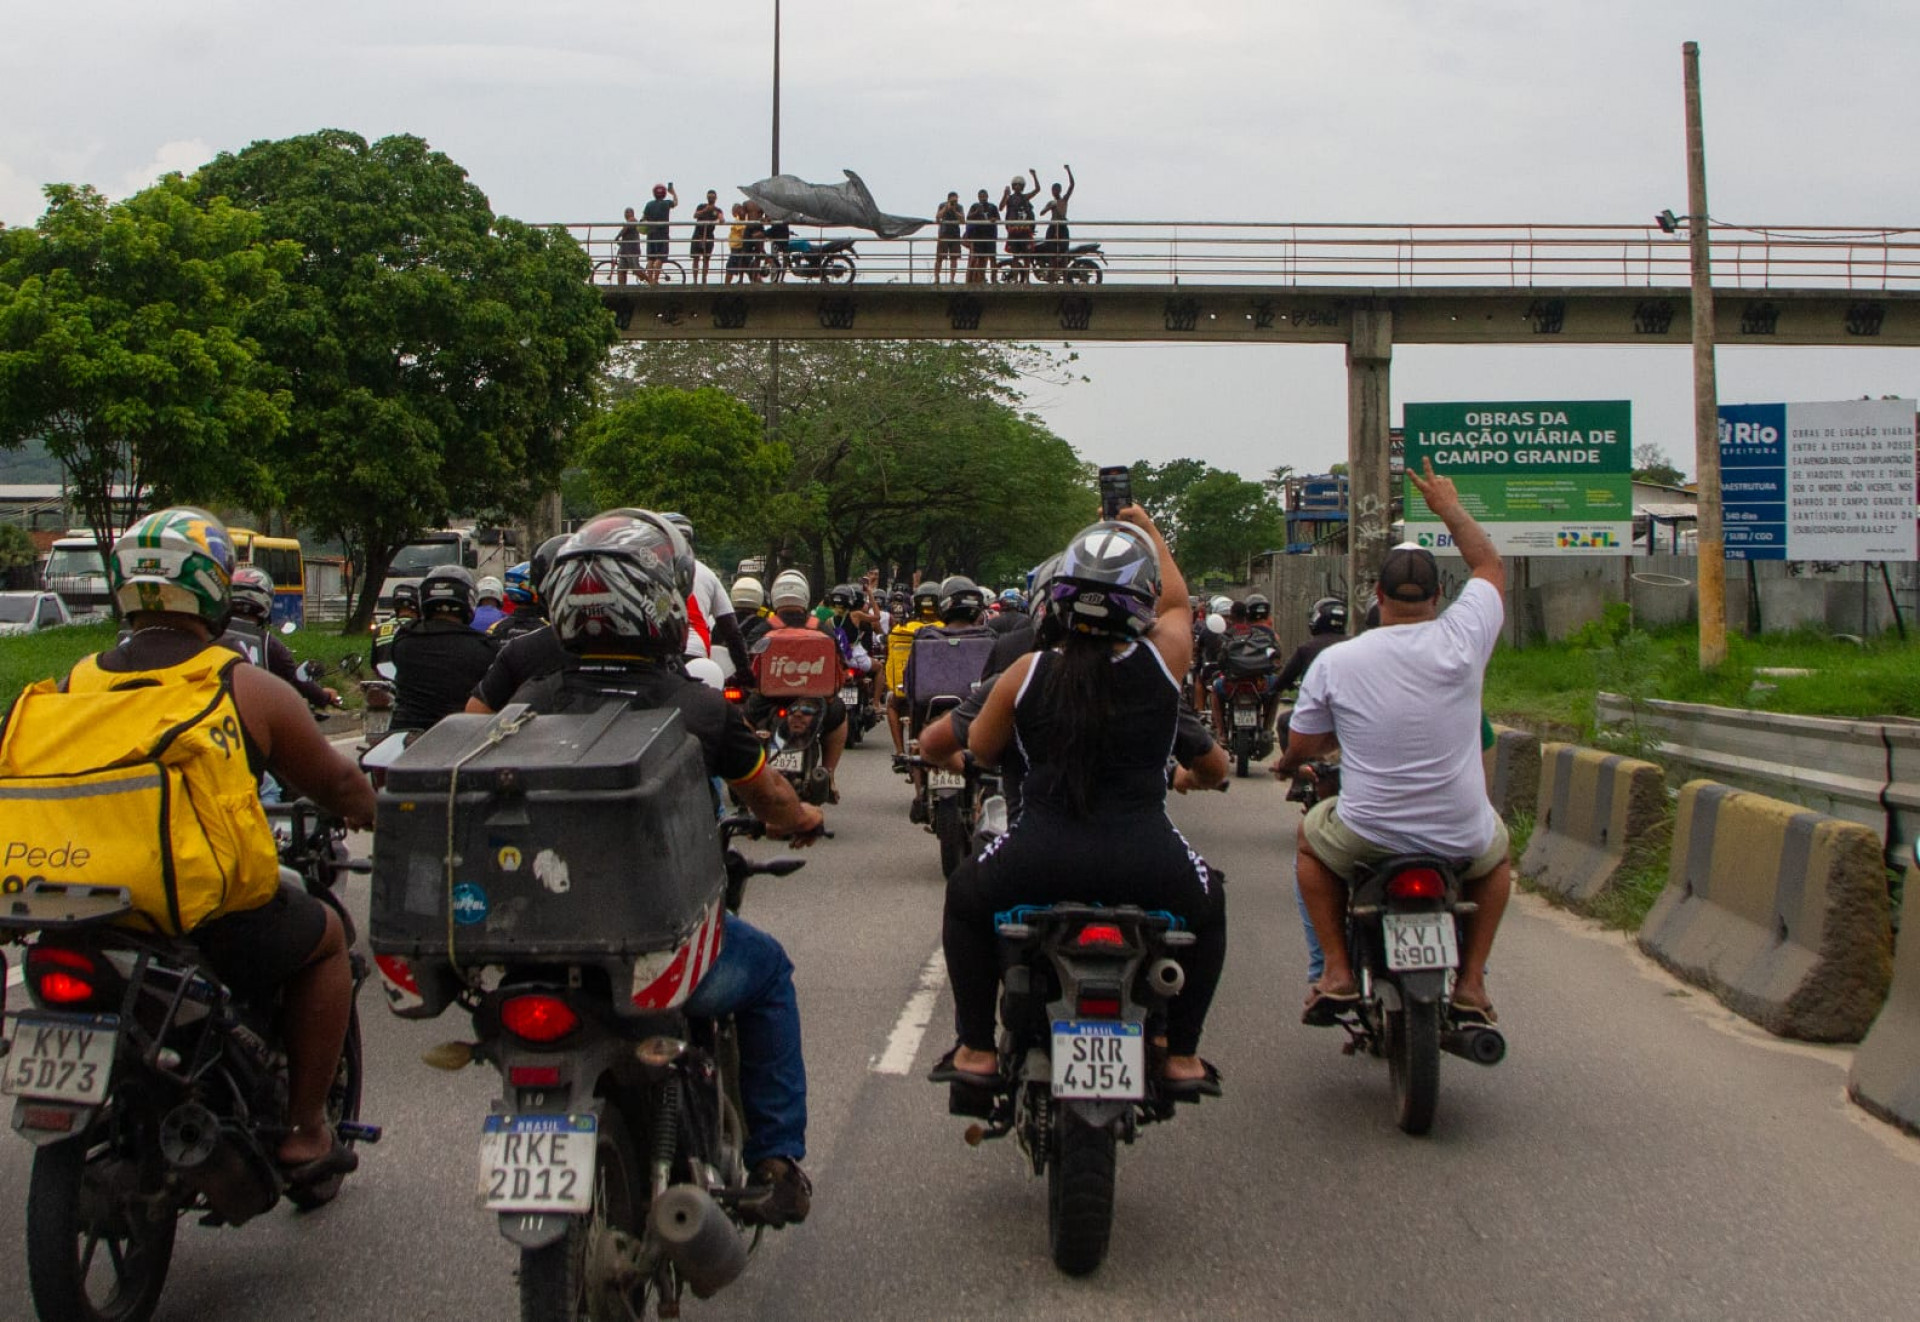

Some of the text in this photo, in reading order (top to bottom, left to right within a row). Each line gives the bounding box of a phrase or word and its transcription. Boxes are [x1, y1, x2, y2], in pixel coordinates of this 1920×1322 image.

[1465, 411, 1569, 426] OBRAS DA
[1418, 427, 1617, 448] LIGAÇÃO VIÁRIA DE
[1735, 422, 1778, 445] Rio
[1434, 449, 1601, 465] CAMPO GRANDE
[1721, 447, 1778, 455] EFEITURA
[1557, 531, 1620, 547] BRASIL
[209, 715, 241, 760] 99
[4, 840, 91, 868] Pede
[33, 1027, 94, 1060] KYY
[1072, 1036, 1123, 1063] SRR
[16, 1057, 98, 1093] 5D73
[1063, 1063, 1132, 1091] 4J54
[516, 1121, 559, 1133] BRASIL
[503, 1132, 569, 1165] RKE
[488, 1167, 577, 1200] 2D12
